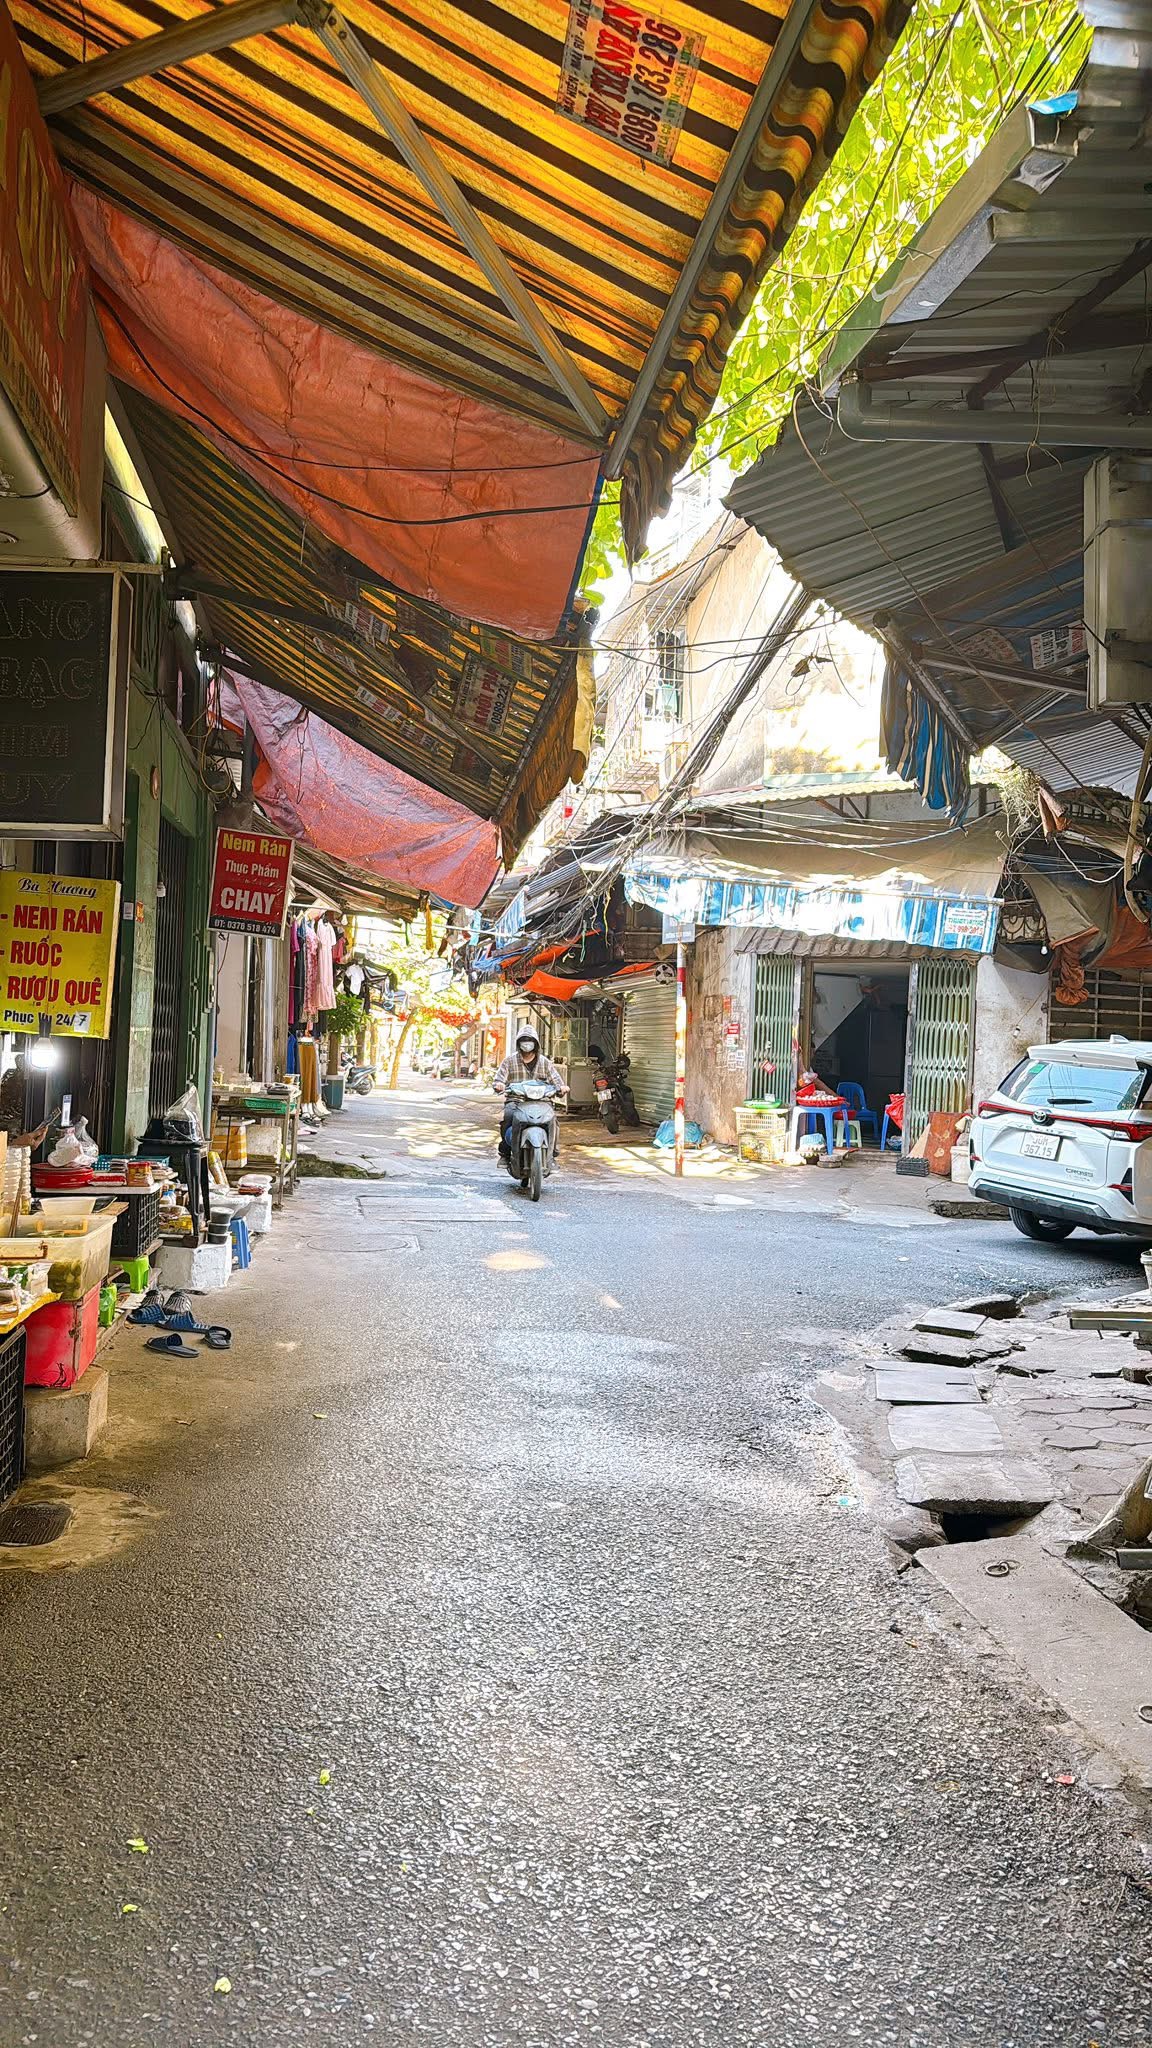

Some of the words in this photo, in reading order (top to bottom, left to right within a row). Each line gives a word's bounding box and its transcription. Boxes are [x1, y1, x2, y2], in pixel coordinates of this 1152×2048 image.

[620, 18, 682, 153] 0989.163.286
[223, 833, 256, 853] Nem
[260, 839, 288, 858] Rán
[225, 859, 249, 876] Thực
[251, 863, 280, 879] Phẩm
[220, 887, 276, 915] CHAY
[13, 904, 58, 931] NEM
[62, 904, 104, 935] RÁN
[10, 934, 63, 967] RUỐC
[7, 974, 60, 1006] RƯỢU
[64, 976, 104, 1006] QUÊ
[4, 1009, 35, 1025] Phục
